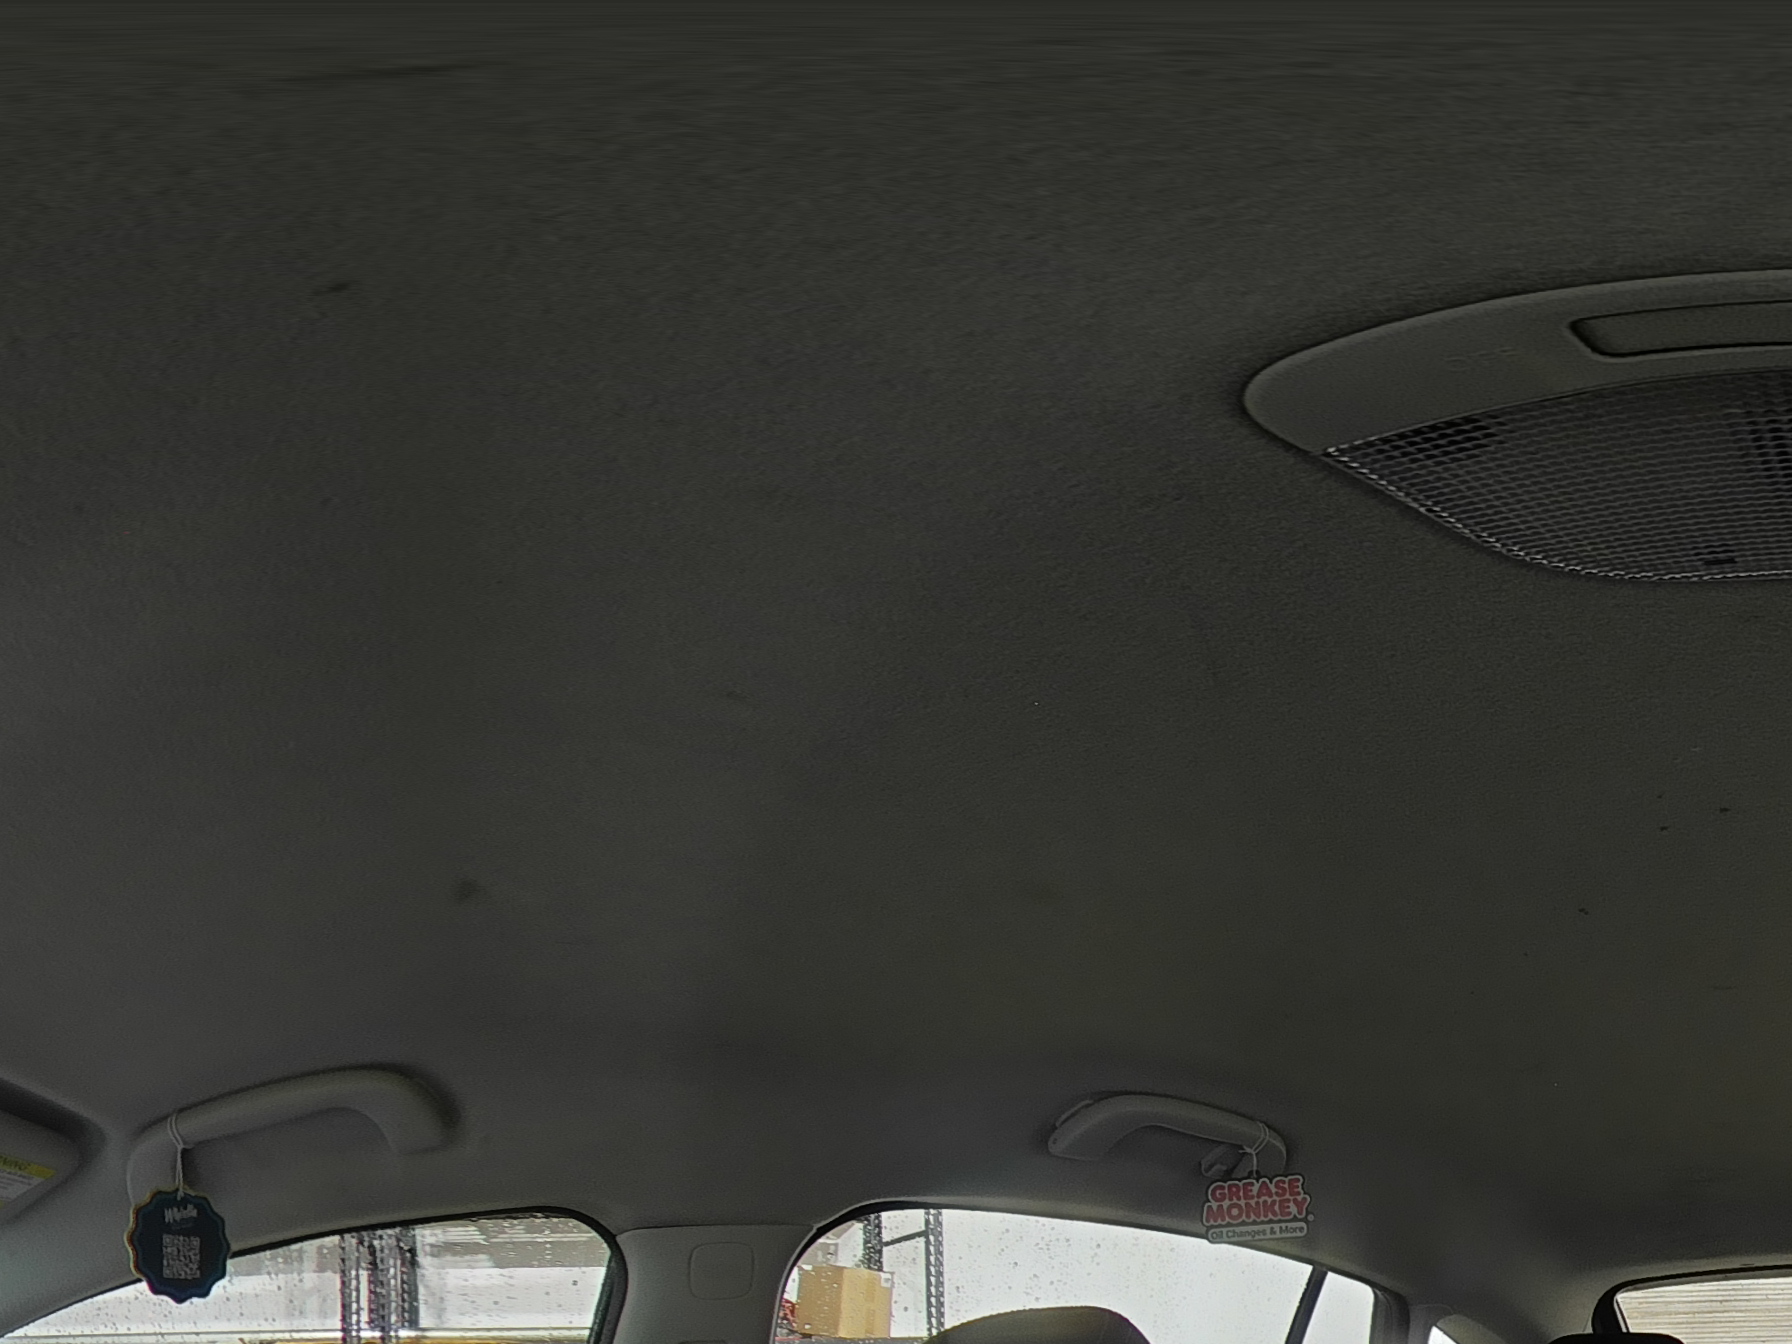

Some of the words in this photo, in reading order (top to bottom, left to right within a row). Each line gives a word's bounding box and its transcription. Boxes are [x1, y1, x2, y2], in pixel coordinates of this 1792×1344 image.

[1210, 1177, 1302, 1203] GREASE
[1204, 1196, 1309, 1224] MONKEY
[1210, 1230, 1224, 1240] Oil
[1226, 1227, 1268, 1240] Changes
[1269, 1226, 1278, 1235] &
[1279, 1225, 1305, 1235] More
